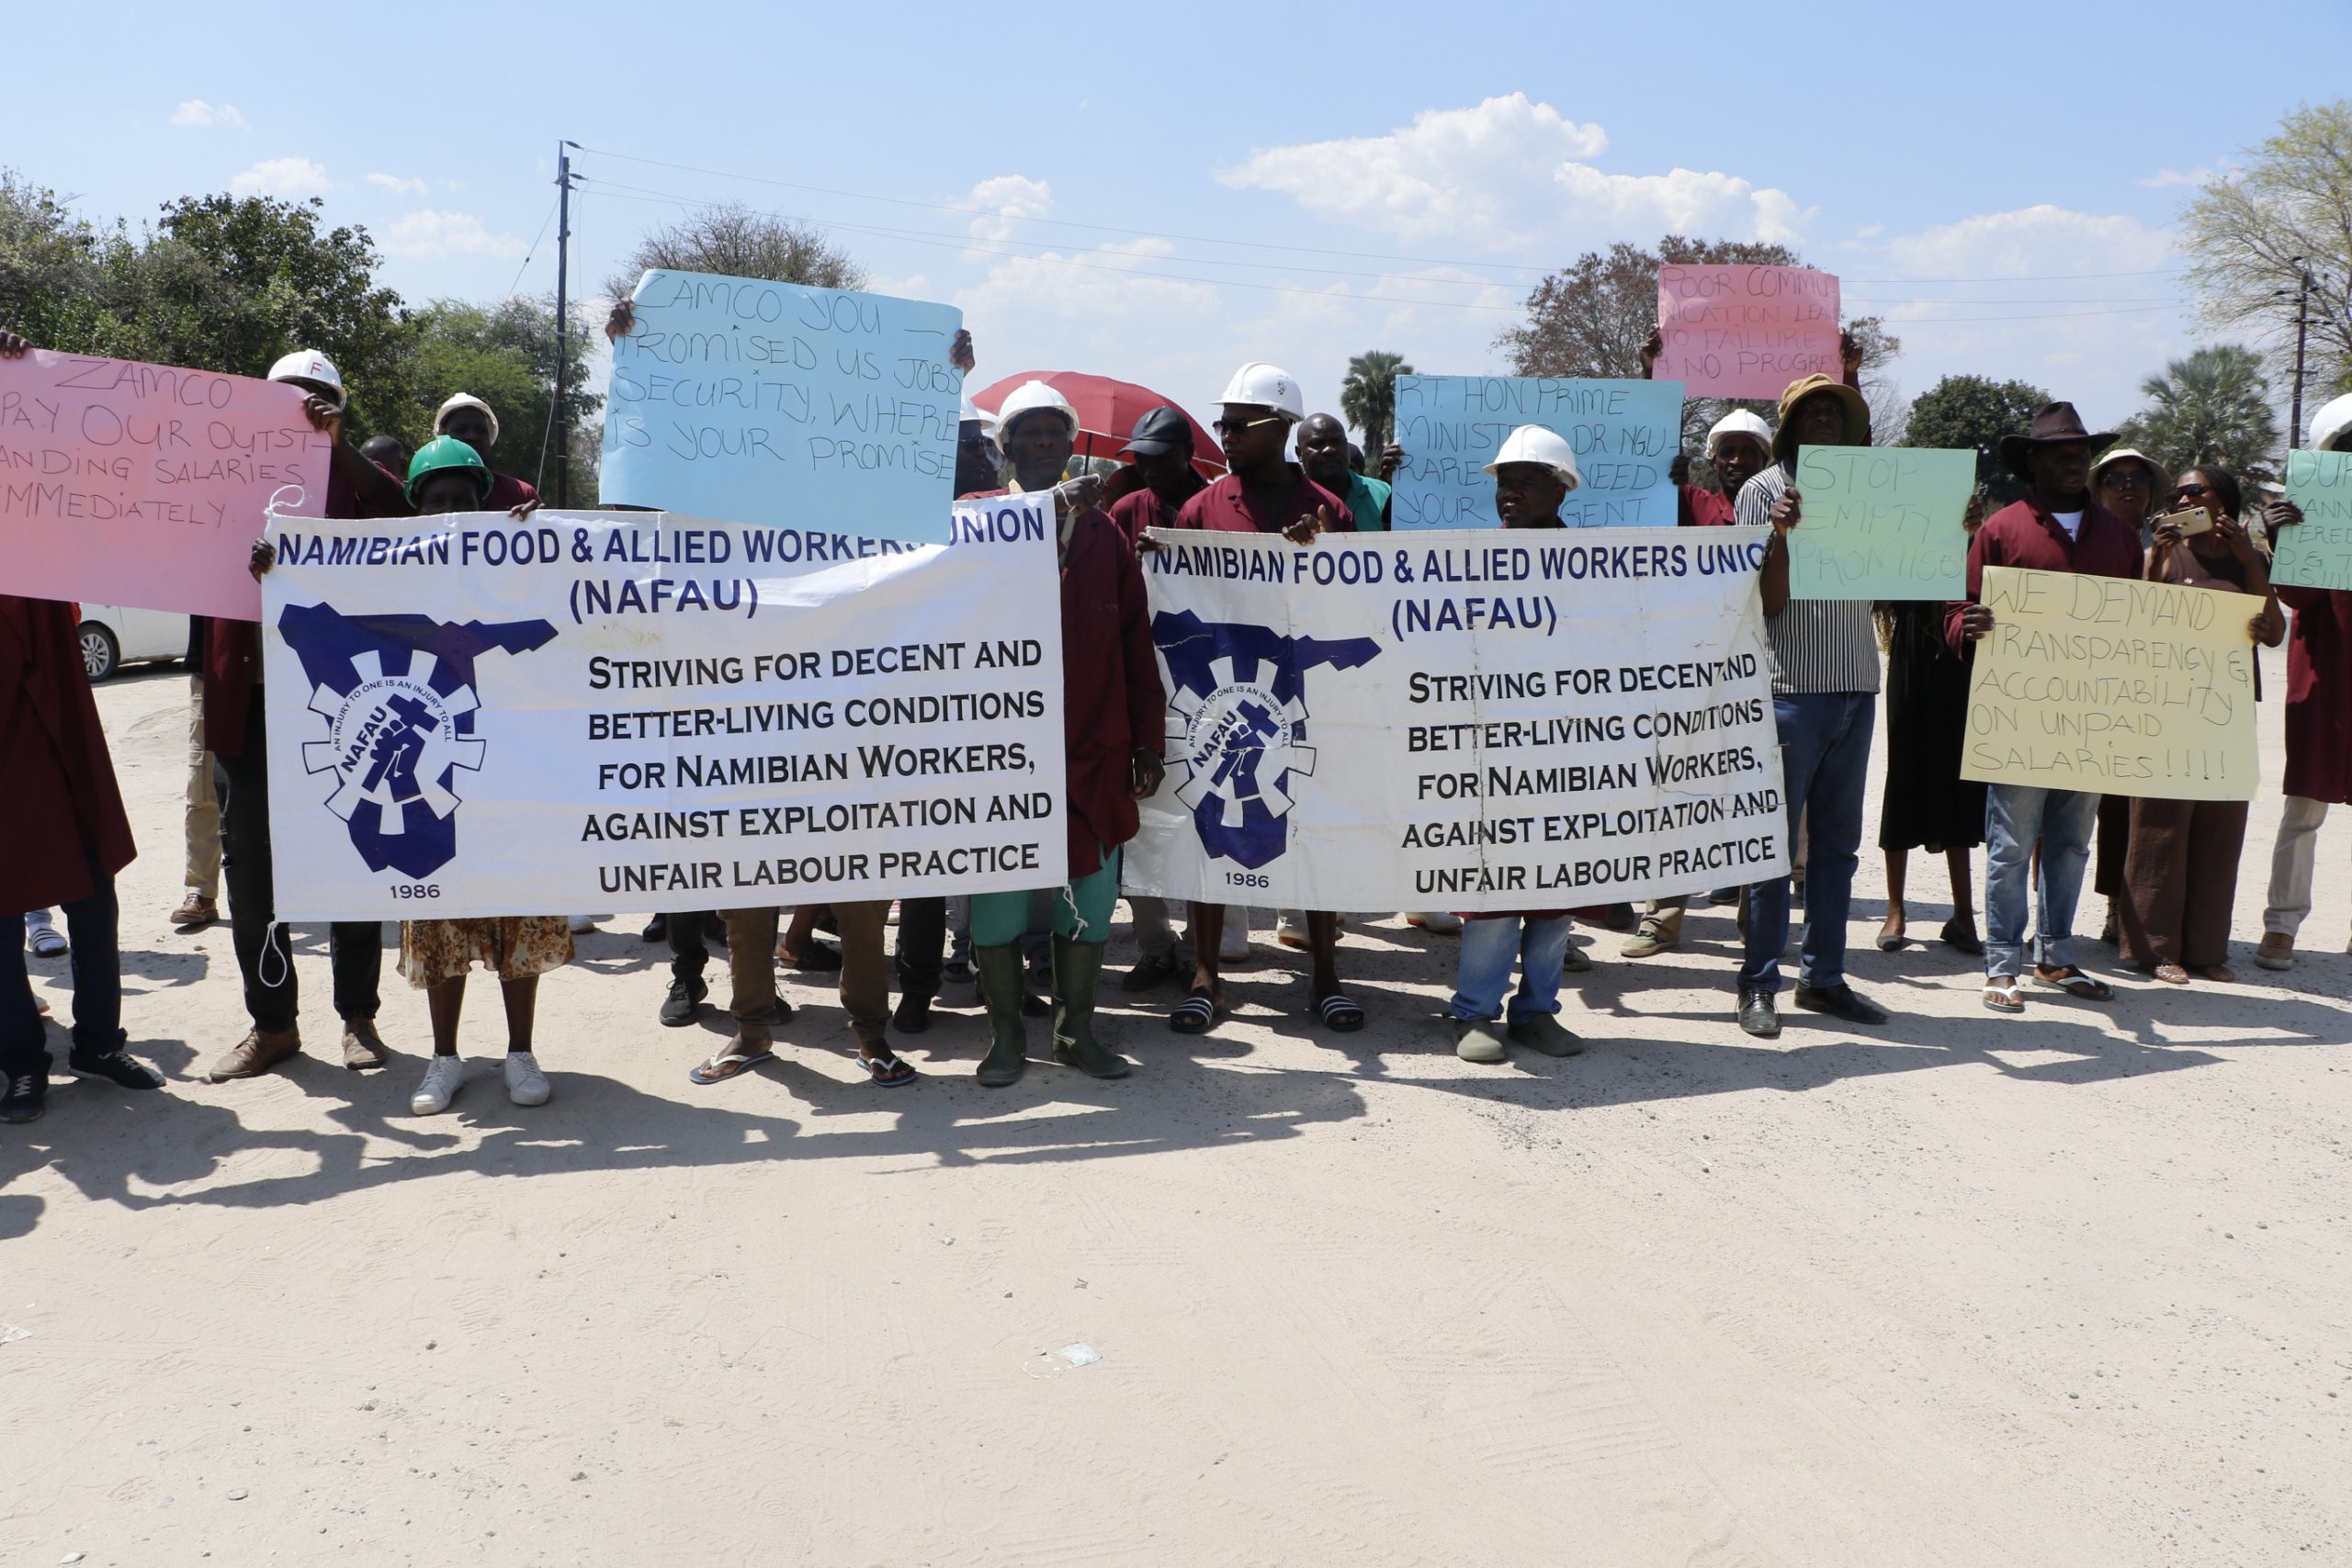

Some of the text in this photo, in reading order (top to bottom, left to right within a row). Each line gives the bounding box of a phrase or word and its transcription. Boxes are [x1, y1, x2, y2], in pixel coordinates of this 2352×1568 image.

[1662, 267, 1736, 299] POOR
[800, 292, 881, 334] YOU
[1659, 329, 1690, 347] TO
[311, 362, 322, 375] F
[837, 348, 881, 380] US
[1685, 354, 1721, 379] NO
[54, 359, 232, 409] ZAMCO
[1, 391, 60, 434] PAY
[82, 404, 190, 451] OUR
[831, 391, 960, 442] WHERE
[1397, 416, 1553, 451] MINIST
[668, 422, 786, 461] YOUR
[1800, 449, 1919, 494] STOP
[1394, 491, 1487, 524] YOUR
[278, 533, 448, 566] NAMIBIAN
[462, 528, 560, 566] FOOD
[571, 528, 593, 562] &
[604, 528, 730, 564] ALLIED
[1153, 543, 1765, 584] NAMIBIAN FOOD & ALLIED WORKERS UNIO
[570, 579, 757, 625] (NAFAU)
[1392, 596, 1556, 641] (NAFAU)
[1988, 570, 2215, 630] WE DEMAND
[589, 639, 1042, 690] STRIVING FOR DECENT AND
[349, 691, 361, 702] TO
[362, 681, 383, 692] ONE
[397, 681, 412, 690] AN
[413, 685, 442, 709] INJURY
[1409, 671, 1546, 703] STRIVING
[1555, 669, 1612, 696] FOR
[334, 702, 350, 735] INJURY
[440, 710, 449, 723] TO
[444, 724, 453, 743] ALL
[589, 691, 1045, 740] BETTER-LIVING CONDITIONS
[1189, 736, 1195, 749] AN
[1206, 694, 1216, 705] TO
[1217, 686, 1235, 697] ONE
[1246, 687, 1259, 695] AN
[1260, 692, 1283, 716] INJURY
[1280, 717, 1288, 730] TO
[1408, 716, 1624, 752] BETTER-LIVING
[1972, 704, 2162, 748] ON UNPAID
[334, 738, 342, 751] AN
[340, 705, 387, 773] NAFAU
[1193, 710, 1237, 768] NAFAU
[598, 762, 665, 790] FOR
[676, 752, 848, 788] NAMIBIAN
[1419, 773, 1479, 800] FOR
[1488, 763, 1637, 796] NAMIBIAN
[582, 792, 1052, 841] AGAINST EXPLOITATION AND
[1401, 789, 1779, 849] AGAINST EXPLOITATION AND
[599, 842, 1039, 893] UNFAIR LABOUR PRACTICE
[1225, 873, 1270, 889] 1986
[1416, 836, 1776, 894] UNFAIR LABOUR PRACTICE
[390, 885, 440, 899] 1986
